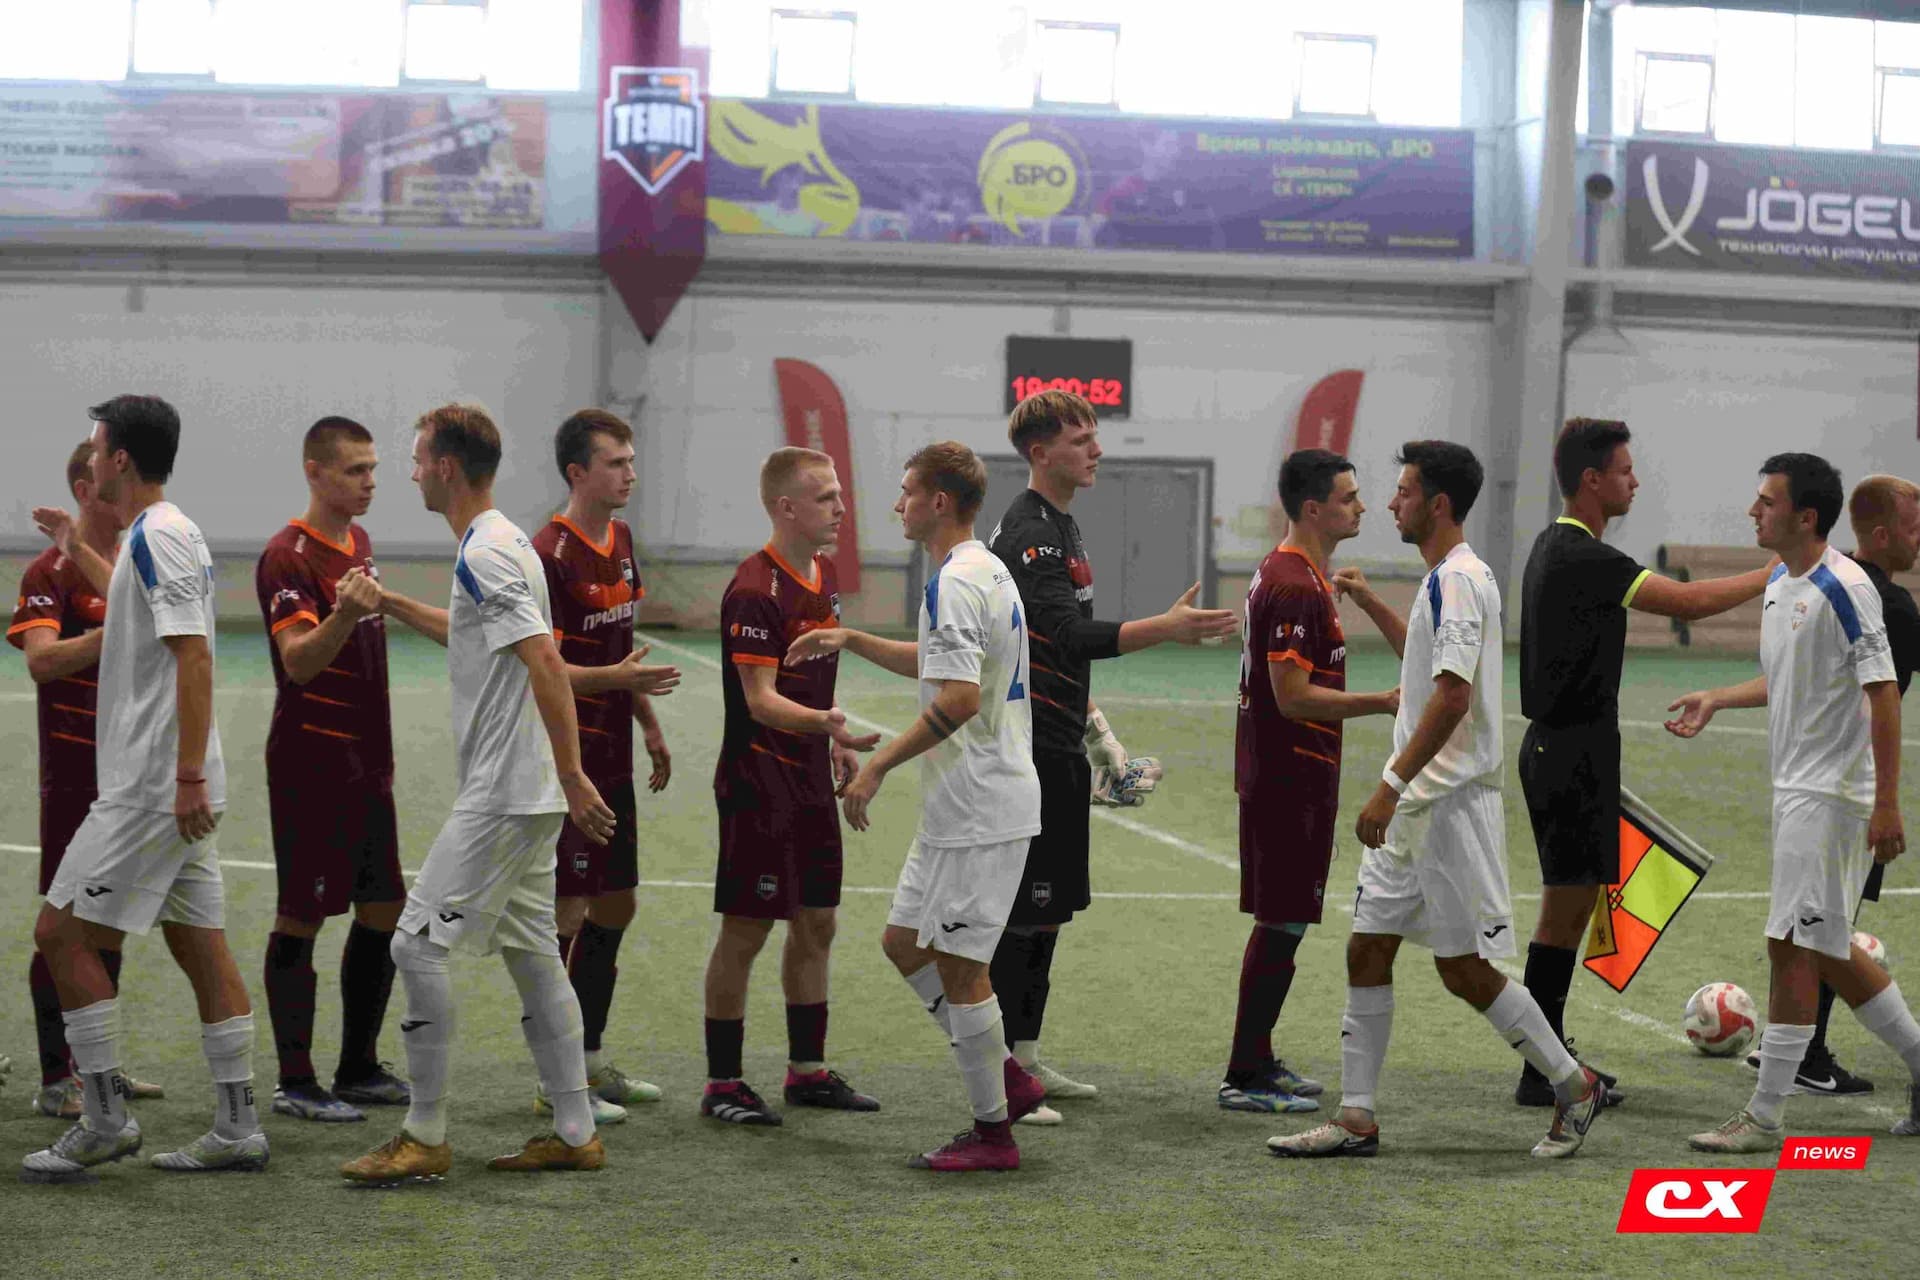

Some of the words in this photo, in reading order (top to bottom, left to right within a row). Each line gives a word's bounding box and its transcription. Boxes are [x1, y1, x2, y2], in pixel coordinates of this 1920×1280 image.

[613, 102, 694, 149] ТЕМП
[1718, 238, 1829, 256] технологии
[741, 625, 769, 640] ПСБ
